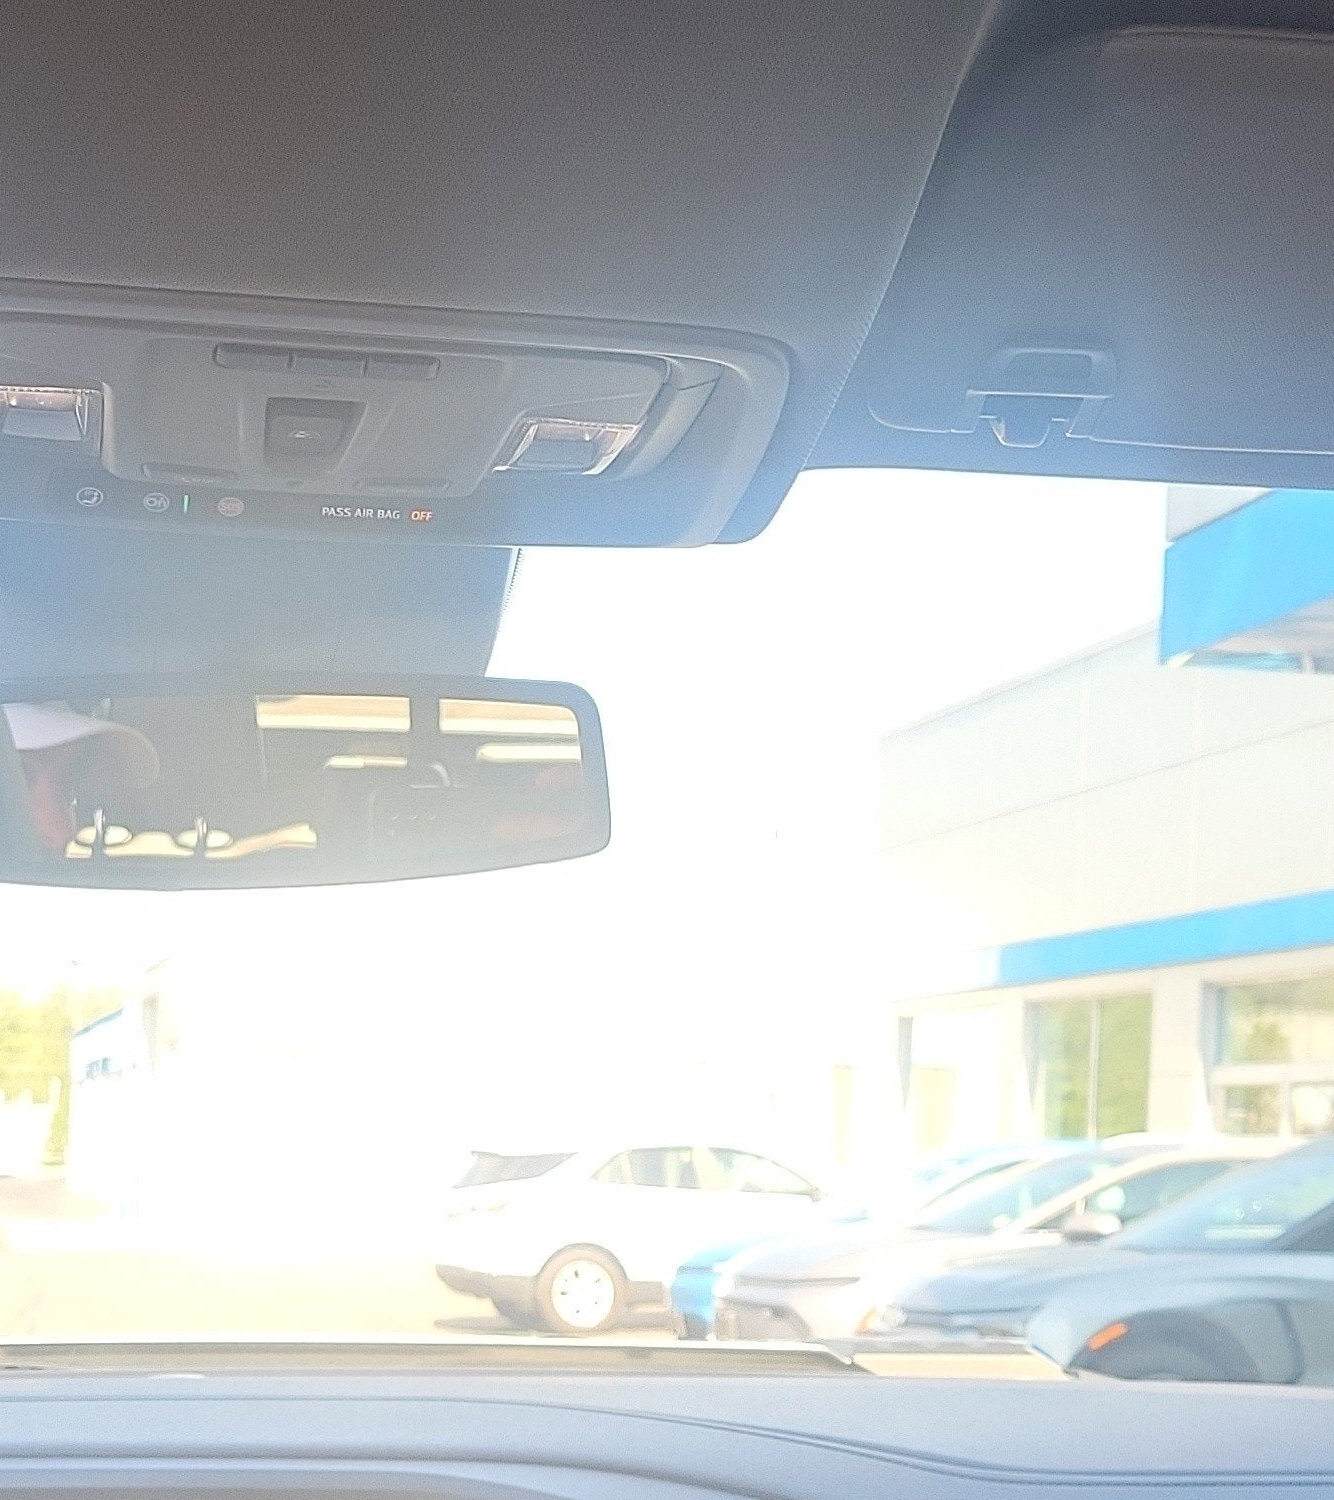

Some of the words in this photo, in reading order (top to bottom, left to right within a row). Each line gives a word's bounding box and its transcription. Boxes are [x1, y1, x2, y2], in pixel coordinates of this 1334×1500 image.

[322, 506, 352, 518] PASS
[354, 508, 374, 518] AIR
[377, 509, 401, 520] BAG
[411, 510, 433, 521] OFF
